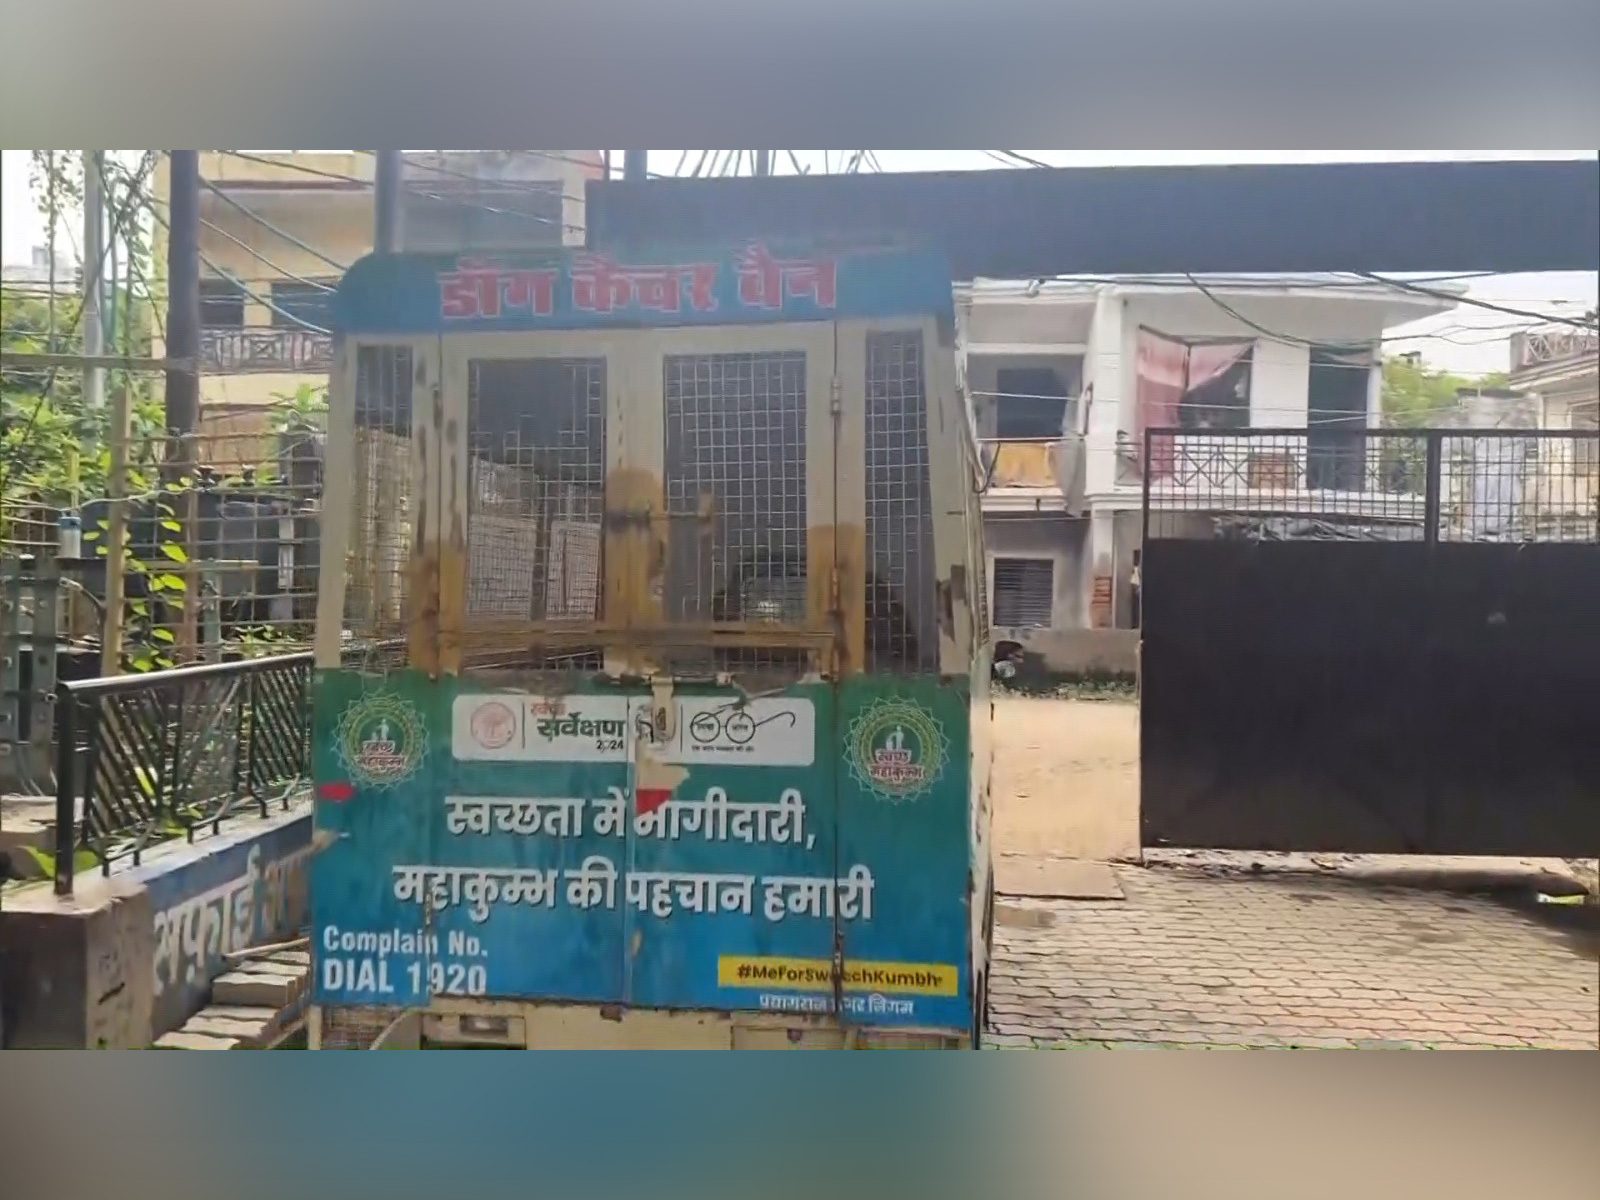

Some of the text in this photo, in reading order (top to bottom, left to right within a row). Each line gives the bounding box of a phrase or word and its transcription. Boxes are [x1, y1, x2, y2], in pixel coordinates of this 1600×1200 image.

[537, 711, 626, 738] सर्वेक्षण
[444, 796, 587, 837] स्वच्छता
[591, 786, 631, 837] में
[392, 855, 876, 923] महाकुम्भ की पहचान हमारी
[323, 925, 489, 957] Complain No.
[323, 958, 488, 996] DIAL 1920
